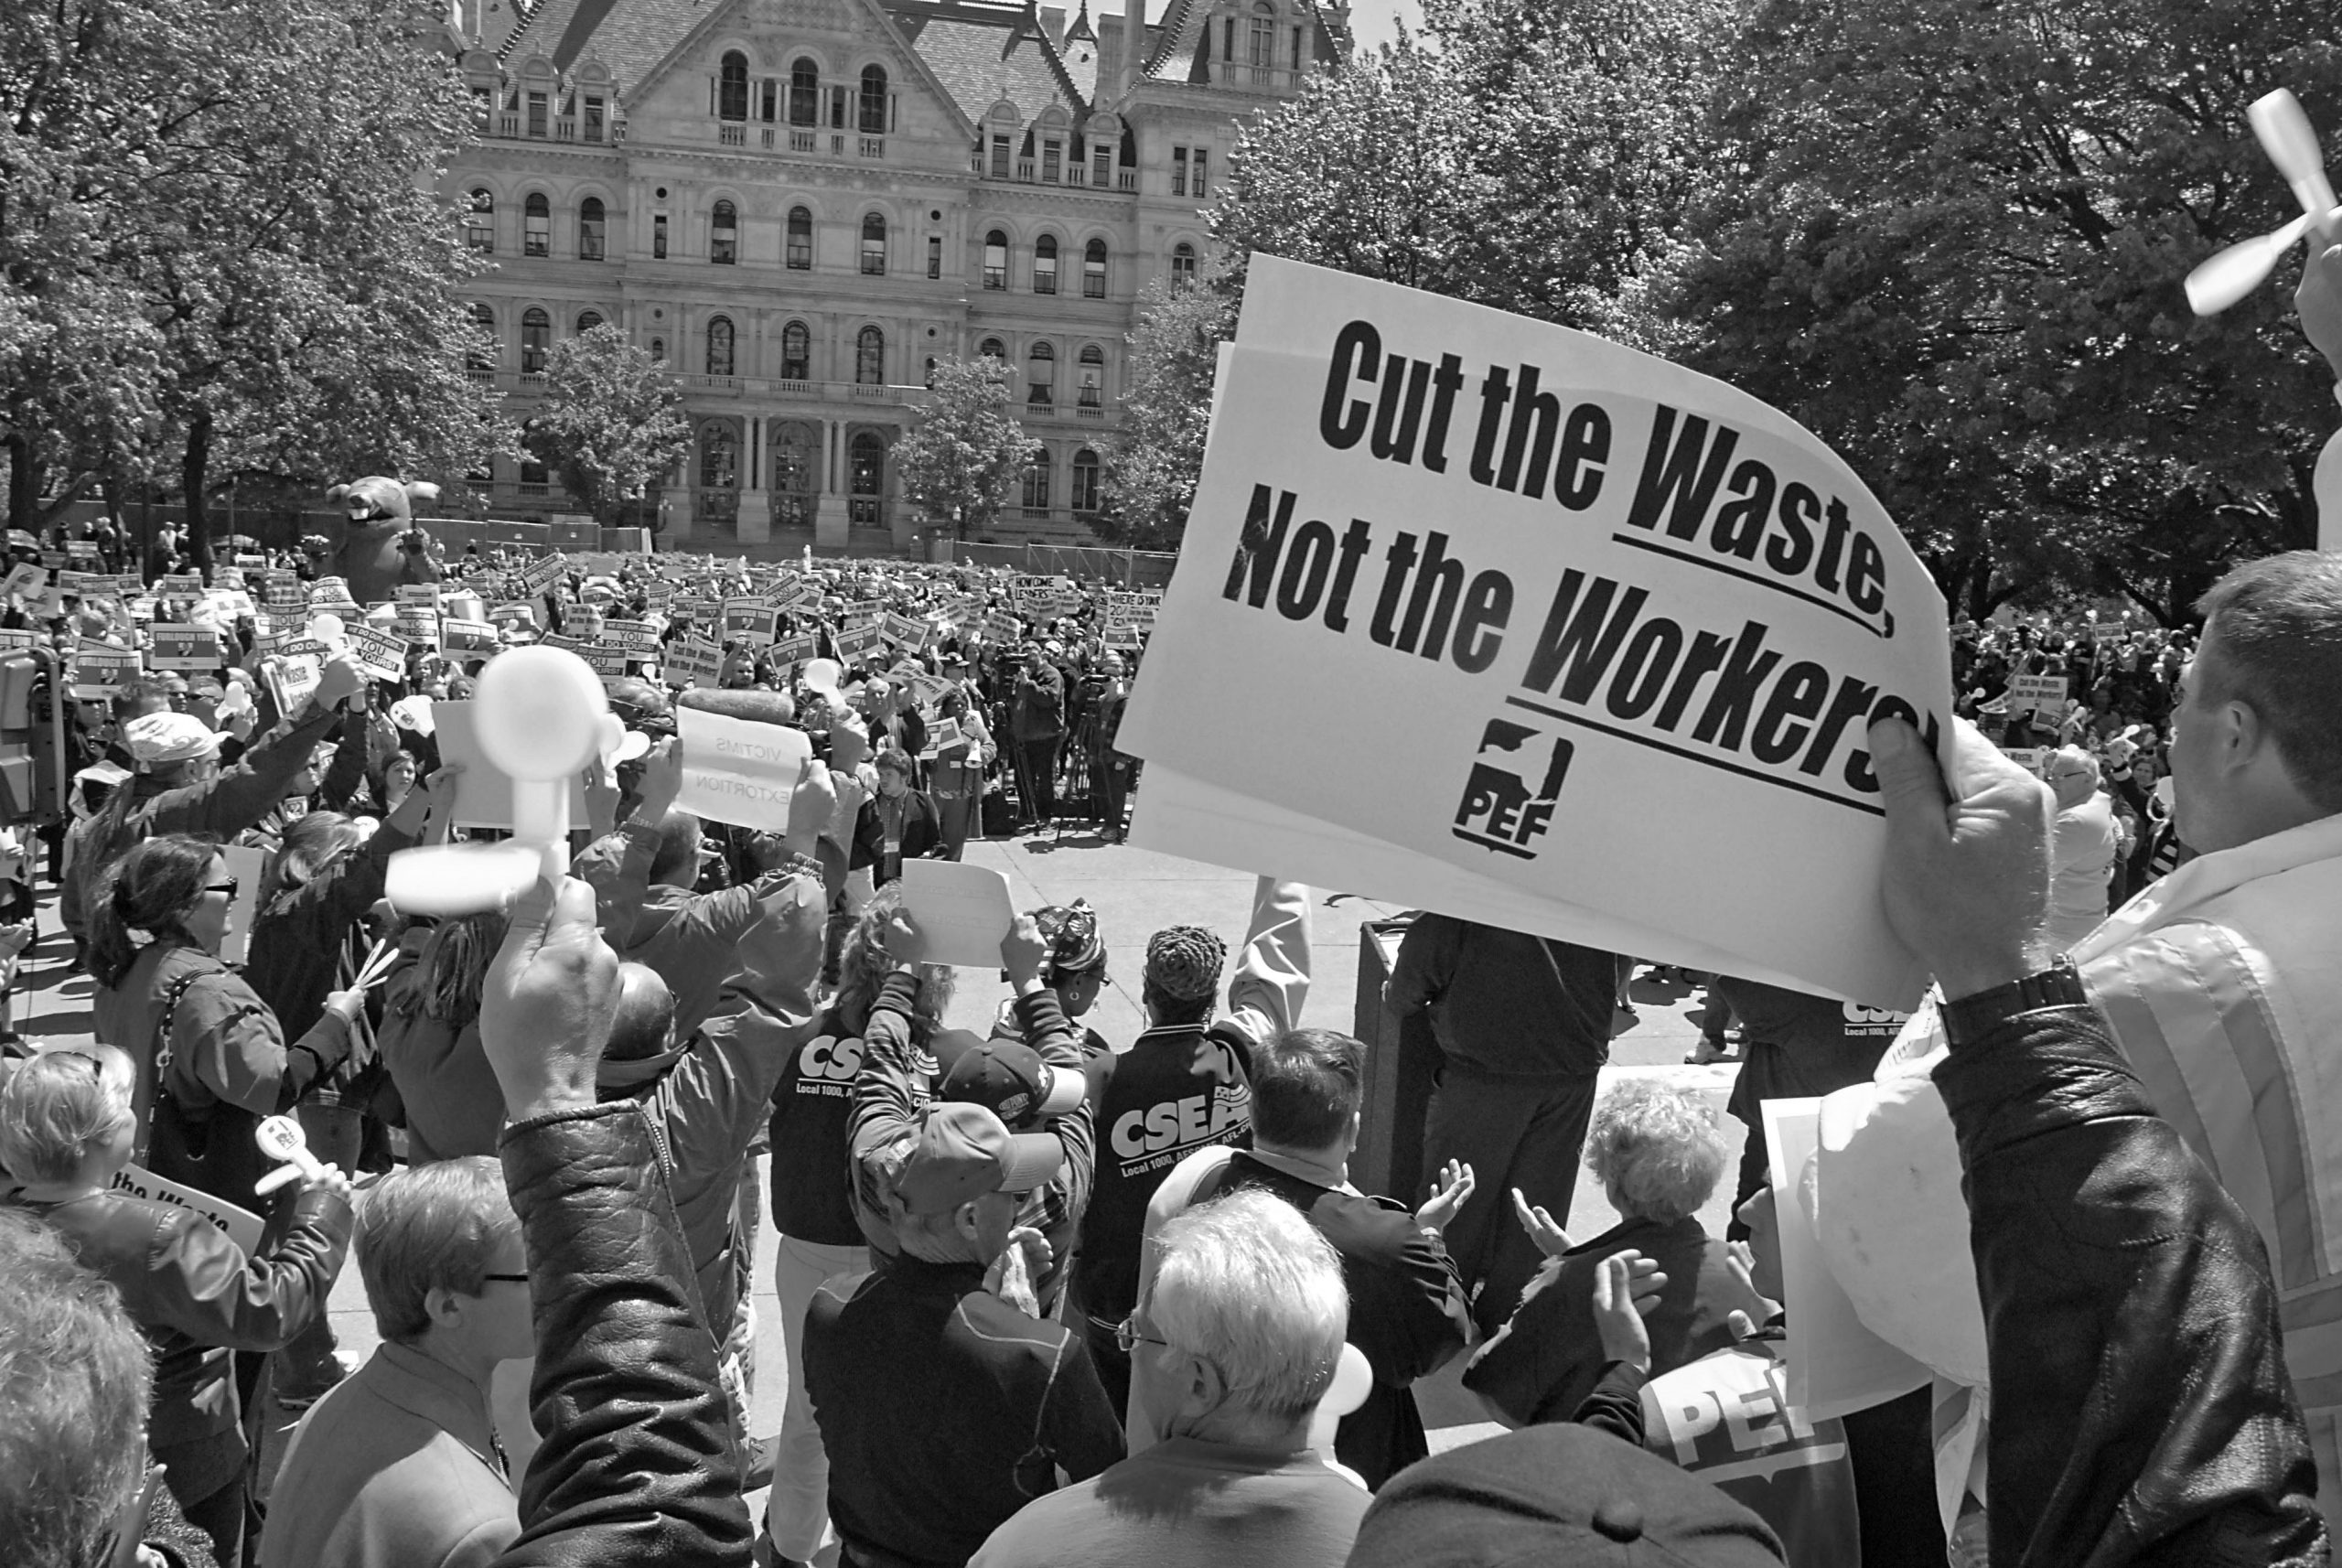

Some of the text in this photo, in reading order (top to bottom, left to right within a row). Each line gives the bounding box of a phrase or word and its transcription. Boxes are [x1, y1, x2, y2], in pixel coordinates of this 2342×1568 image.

[1319, 319, 1463, 474] Cut
[1470, 362, 1612, 511] the
[1016, 577, 1054, 587] HOW COME
[1222, 482, 1371, 634] Not
[1370, 530, 1515, 674] the
[620, 631, 643, 641] YOU
[290, 643, 304, 651] DO
[360, 638, 386, 656] YOU
[1844, 1027, 1867, 1036] Local
[796, 1083, 820, 1095] Local
[822, 1084, 844, 1098] 1000,
[1111, 1083, 1252, 1158] CSEA
[1121, 1162, 1149, 1178] Local
[1150, 1154, 1176, 1170] 1000,
[112, 1172, 147, 1199] the
